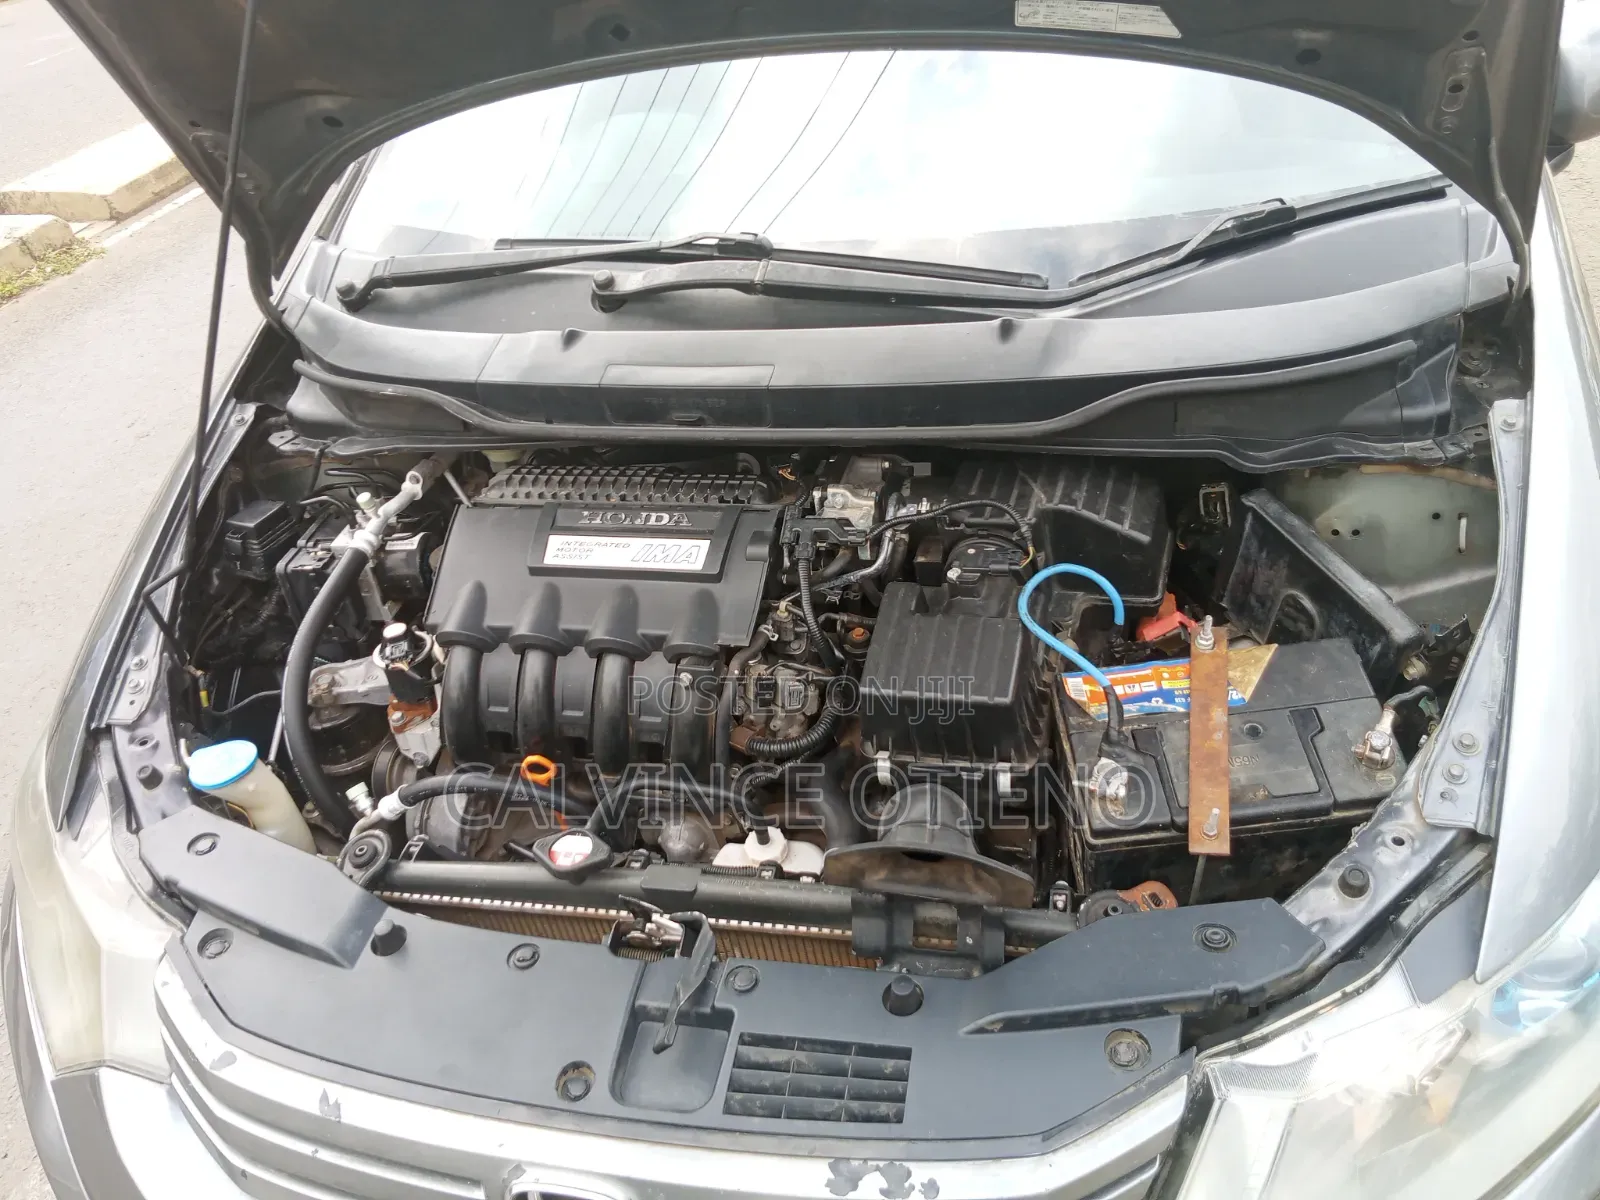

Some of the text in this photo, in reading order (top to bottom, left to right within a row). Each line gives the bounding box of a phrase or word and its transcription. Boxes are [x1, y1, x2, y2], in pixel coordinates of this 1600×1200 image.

[578, 511, 692, 527] HONDA
[560, 540, 631, 549] INTEGRATED
[630, 543, 702, 564] IMA
